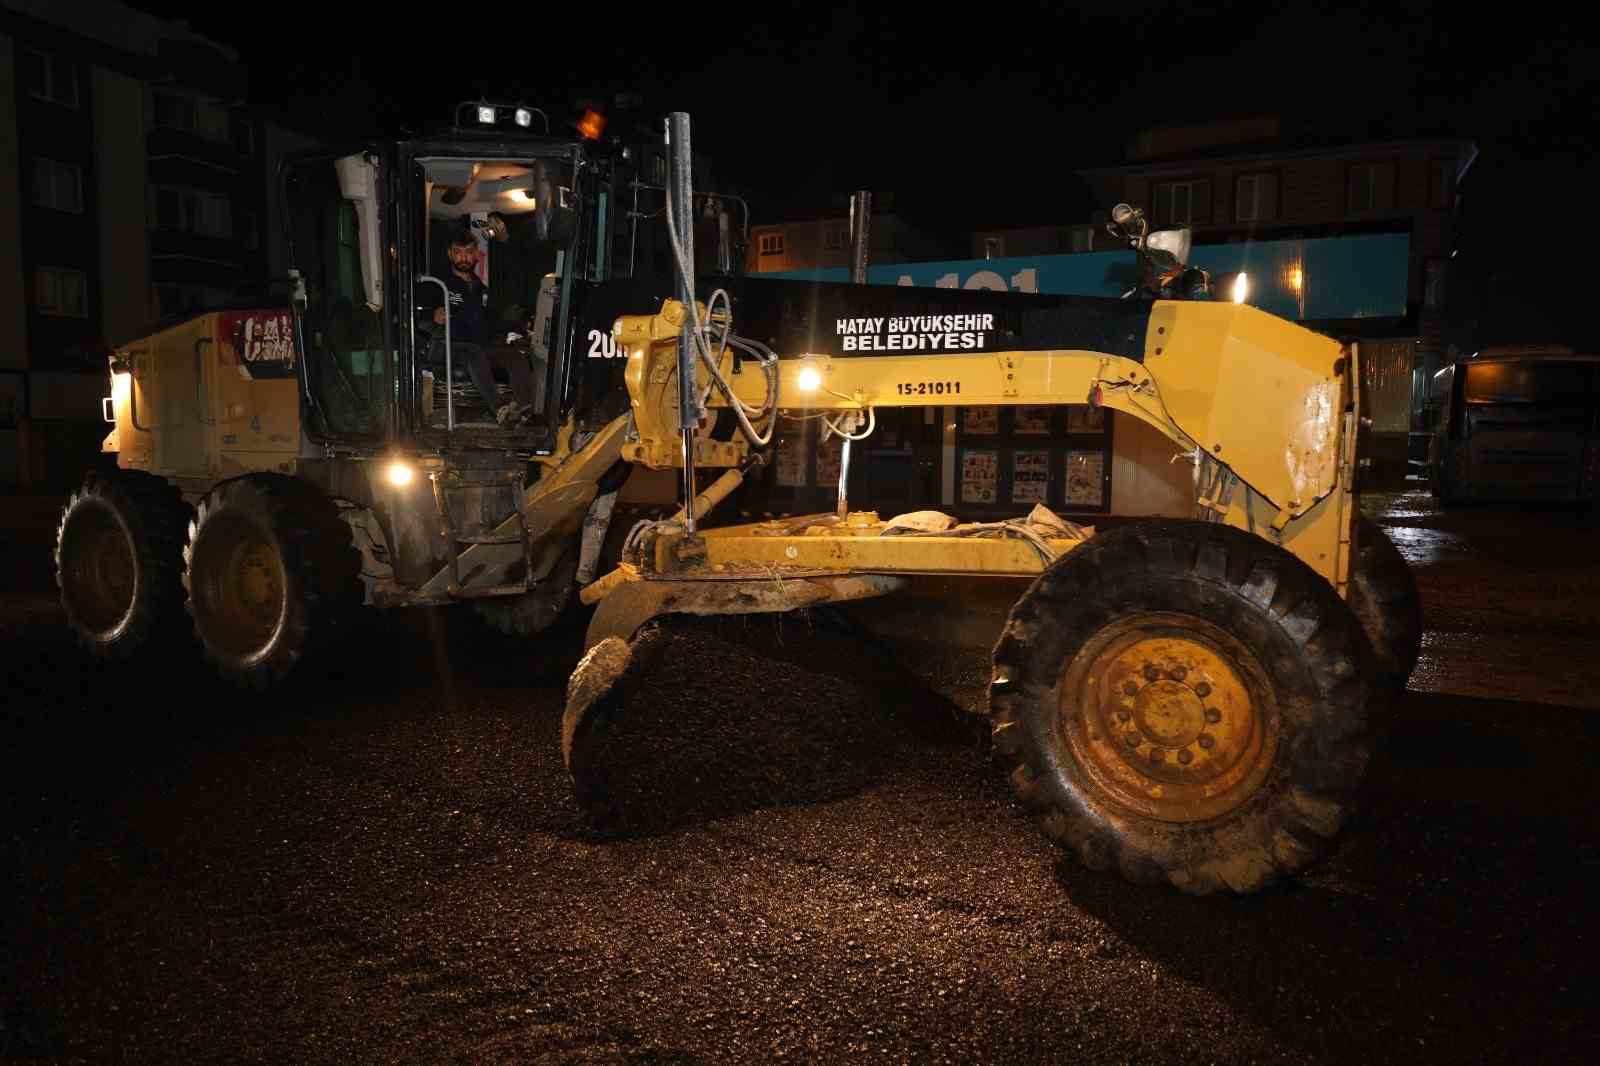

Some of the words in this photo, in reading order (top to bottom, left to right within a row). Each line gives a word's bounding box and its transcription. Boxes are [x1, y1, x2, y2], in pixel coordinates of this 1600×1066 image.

[836, 317, 885, 336] HATAY
[842, 332, 985, 352] BELEDİYESİ
[897, 381, 961, 395] 15-21011
